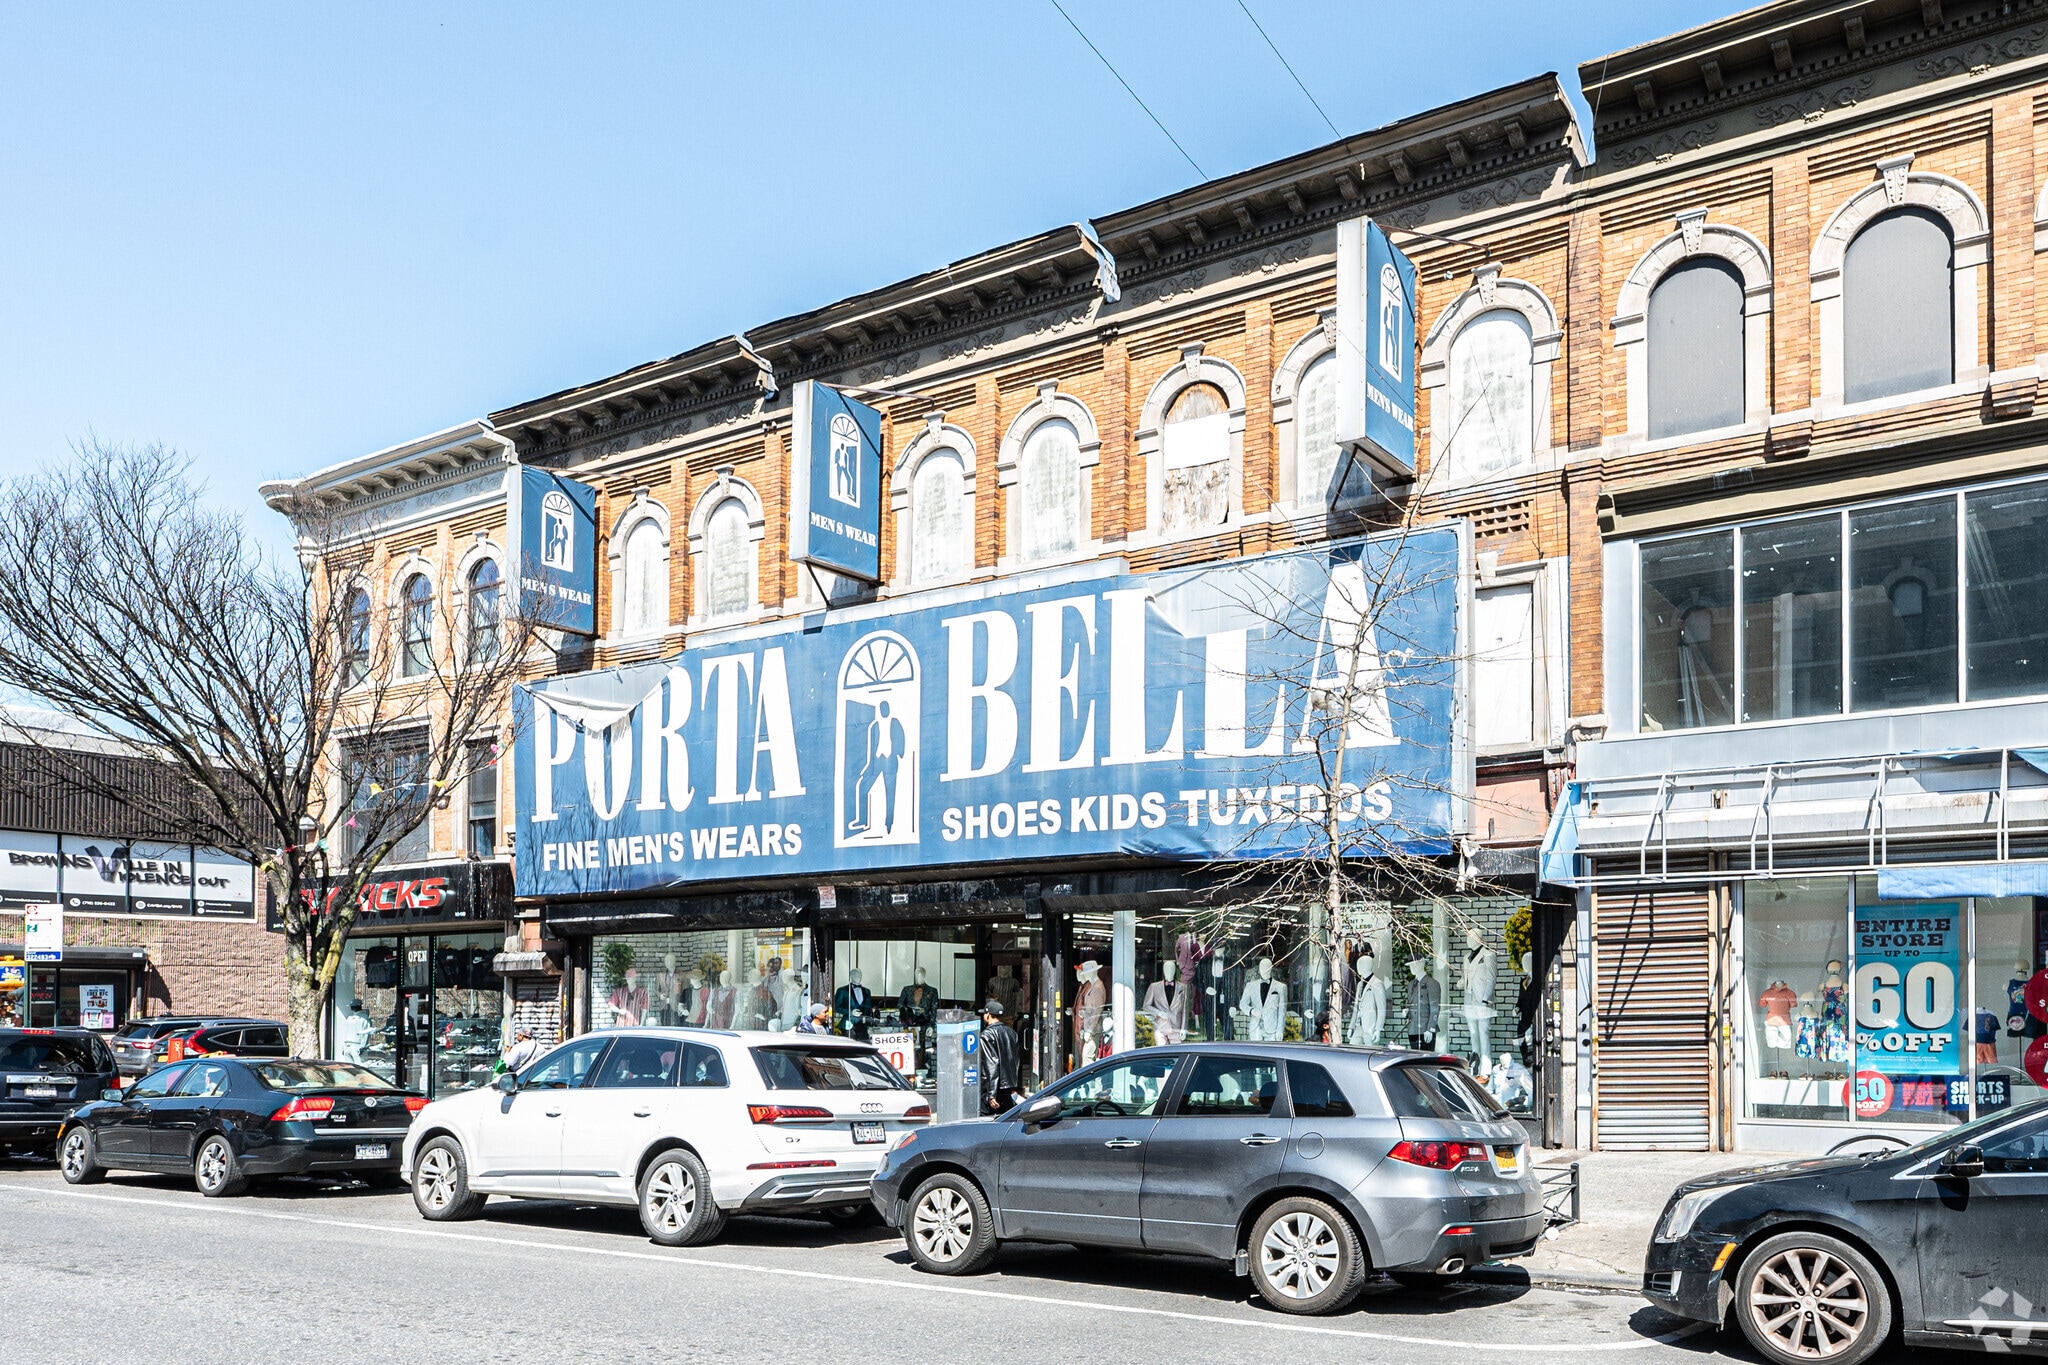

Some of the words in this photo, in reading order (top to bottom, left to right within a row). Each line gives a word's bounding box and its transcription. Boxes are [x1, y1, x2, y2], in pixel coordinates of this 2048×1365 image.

[1390, 401, 1414, 433] WEAR
[845, 524, 877, 548] WEAR
[558, 586, 592, 606] WEAR
[531, 646, 807, 823] PORTA
[940, 560, 1402, 783] BELLA
[941, 798, 1062, 842] SHOES
[1070, 791, 1167, 833] KIDS
[1179, 780, 1393, 827] TUXEDOS
[543, 840, 601, 872] FINE
[607, 831, 685, 868] MEN'S
[690, 823, 802, 860] WEARS
[197, 876, 230, 889] OUT
[1856, 918, 1951, 933] ENTIRE
[1861, 933, 1943, 948] STORE
[408, 950, 427, 962] OPEN
[1904, 949, 1920, 957] TO
[1856, 961, 1955, 1031] 60
[874, 1035, 909, 1045] SHOES
[966, 1034, 976, 1052] P
[1856, 1077, 1887, 1102] 50
[1950, 1080, 2005, 1095] SHRTS
[1950, 1094, 2005, 1105] STOK-UP
